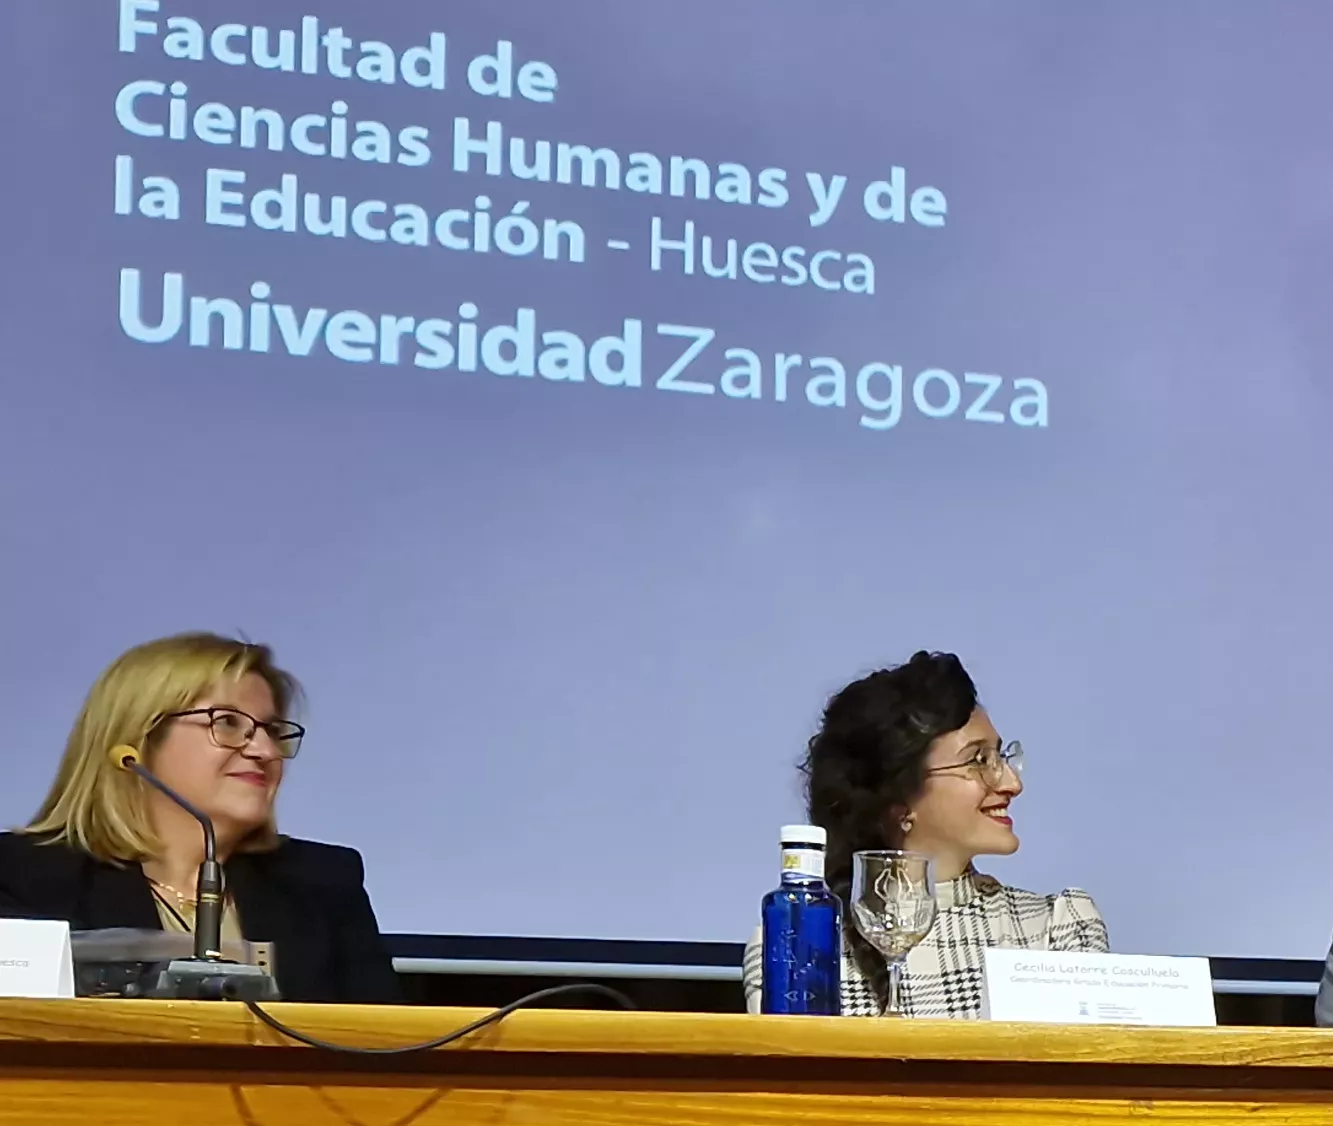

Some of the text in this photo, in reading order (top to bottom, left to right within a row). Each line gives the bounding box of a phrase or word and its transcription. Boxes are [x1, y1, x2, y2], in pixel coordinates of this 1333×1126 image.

[118, 0, 558, 103] Facultad de
[115, 80, 948, 227] Ciencias Humanas y de
[114, 154, 180, 220] la
[205, 168, 585, 263] Educación
[650, 216, 875, 295] Huesca
[1014, 962, 1056, 973] Cecilia
[1059, 963, 1108, 976] Latorre
